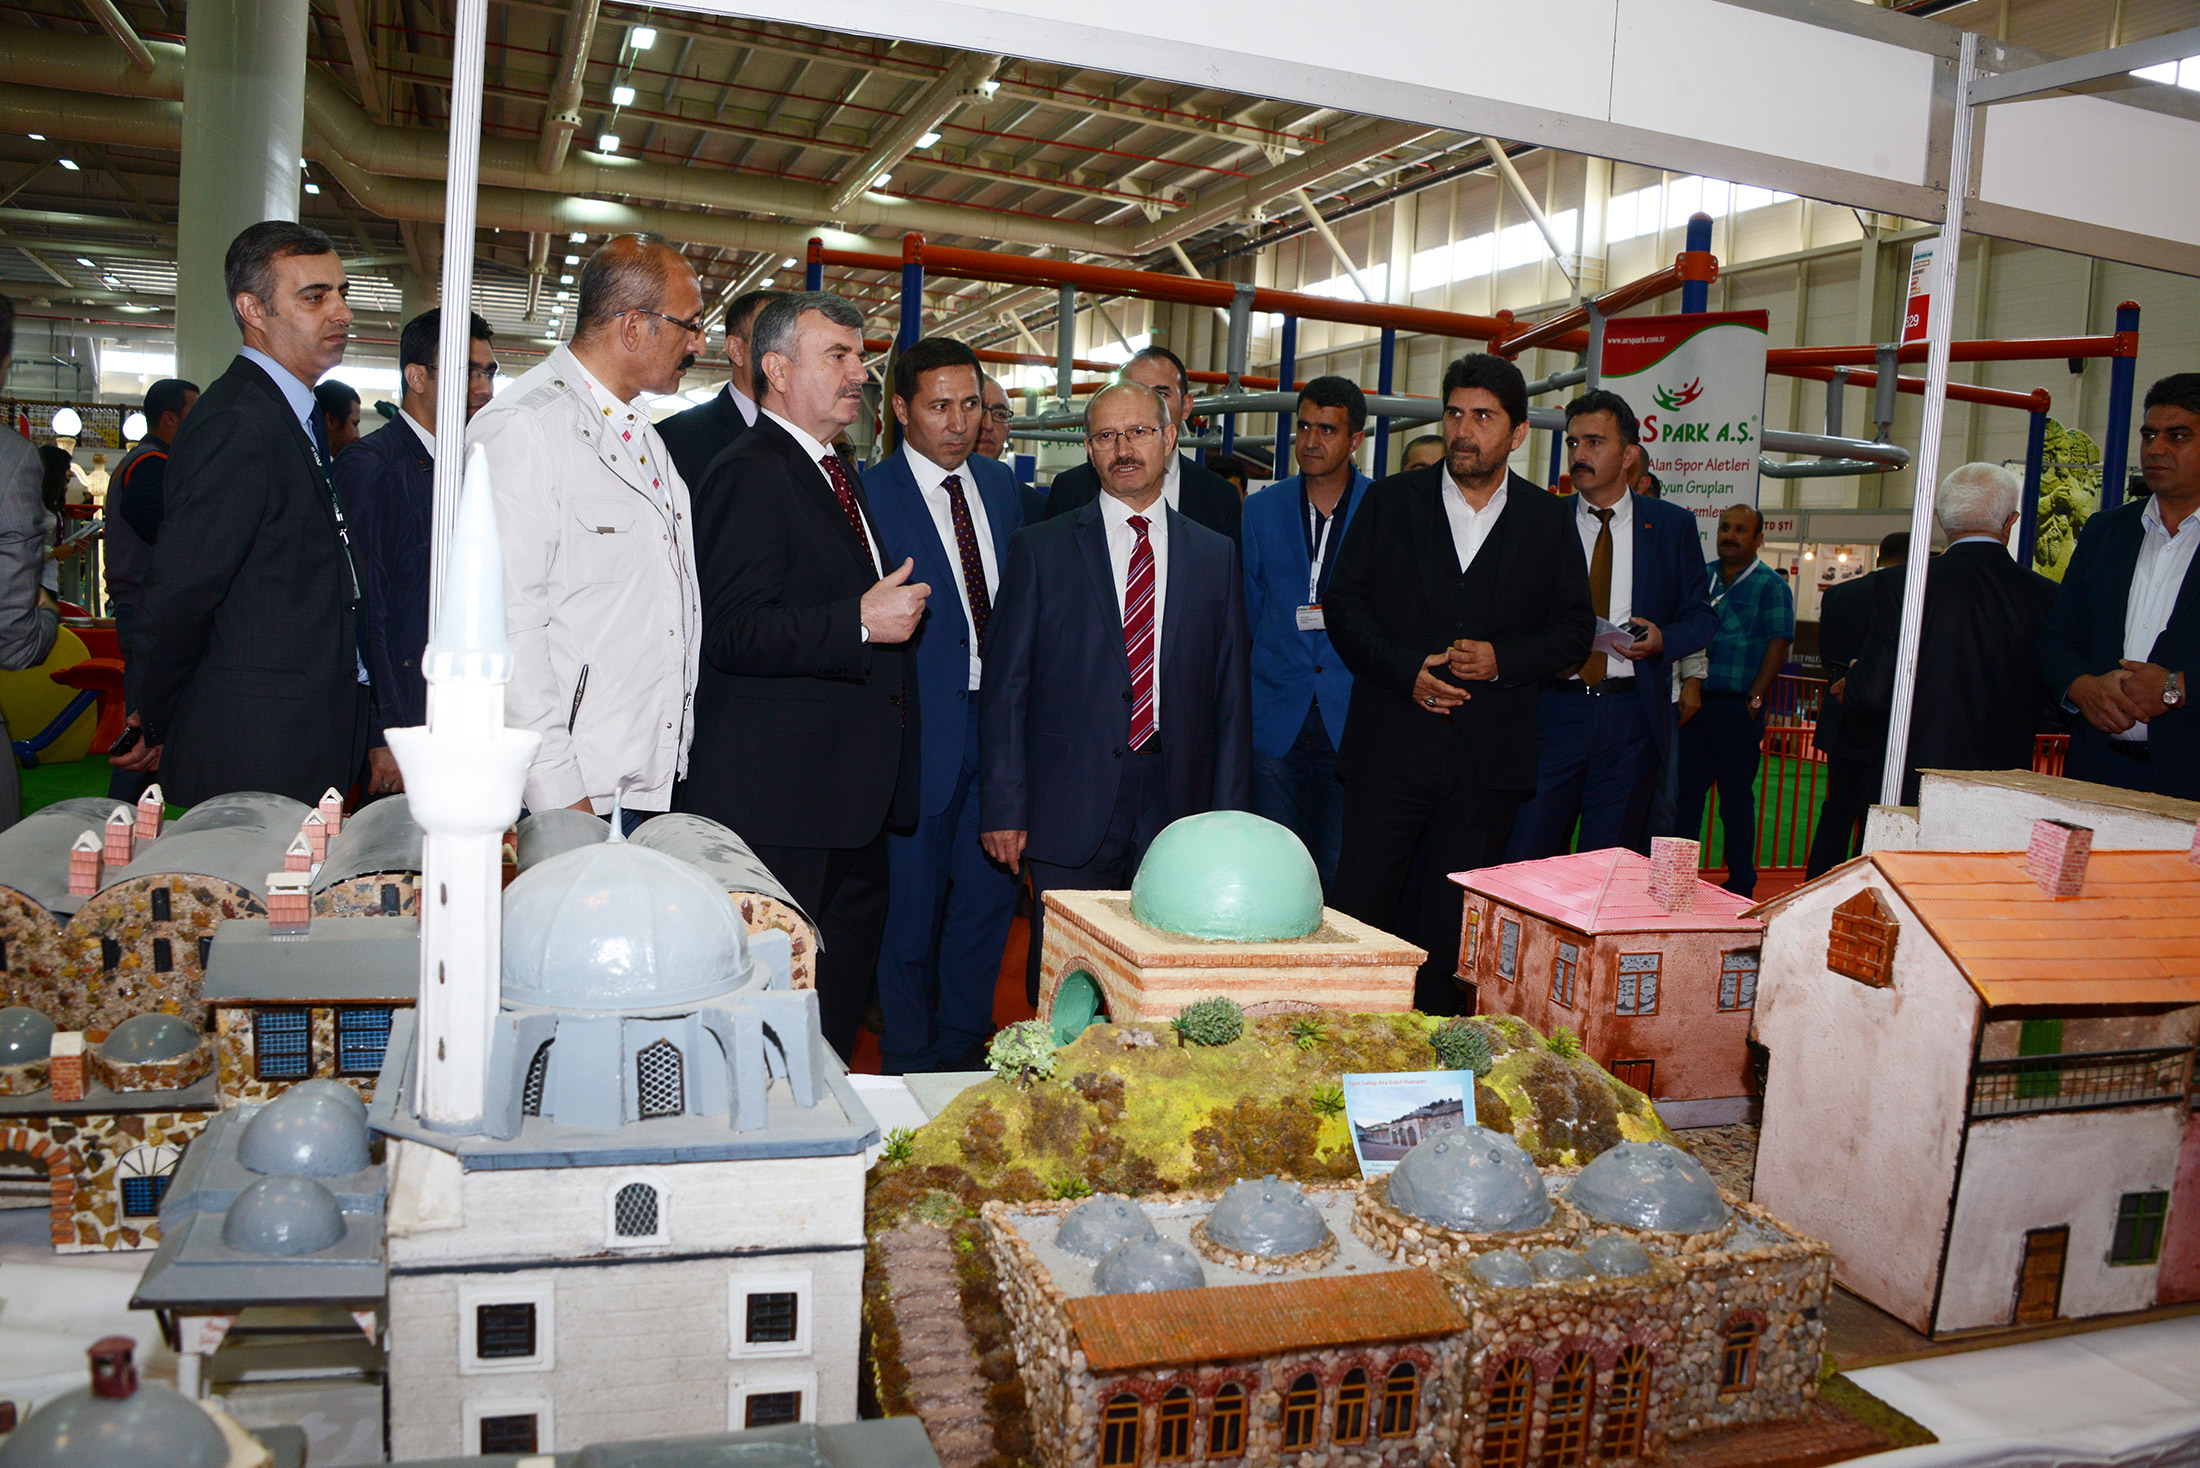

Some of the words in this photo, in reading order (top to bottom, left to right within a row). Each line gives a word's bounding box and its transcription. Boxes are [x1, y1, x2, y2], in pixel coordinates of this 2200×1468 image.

[1607, 335, 1665, 345] www.arspark.com.tr
[1662, 423, 1710, 443] PARK
[1716, 422, 1754, 445] A.Ş.
[1648, 458, 1672, 471] Alan
[1674, 458, 1703, 476] Spor
[1705, 458, 1750, 471] Aletleri
[1686, 480, 1734, 498] Grupları
[1778, 519, 1793, 532] ŞTİ
